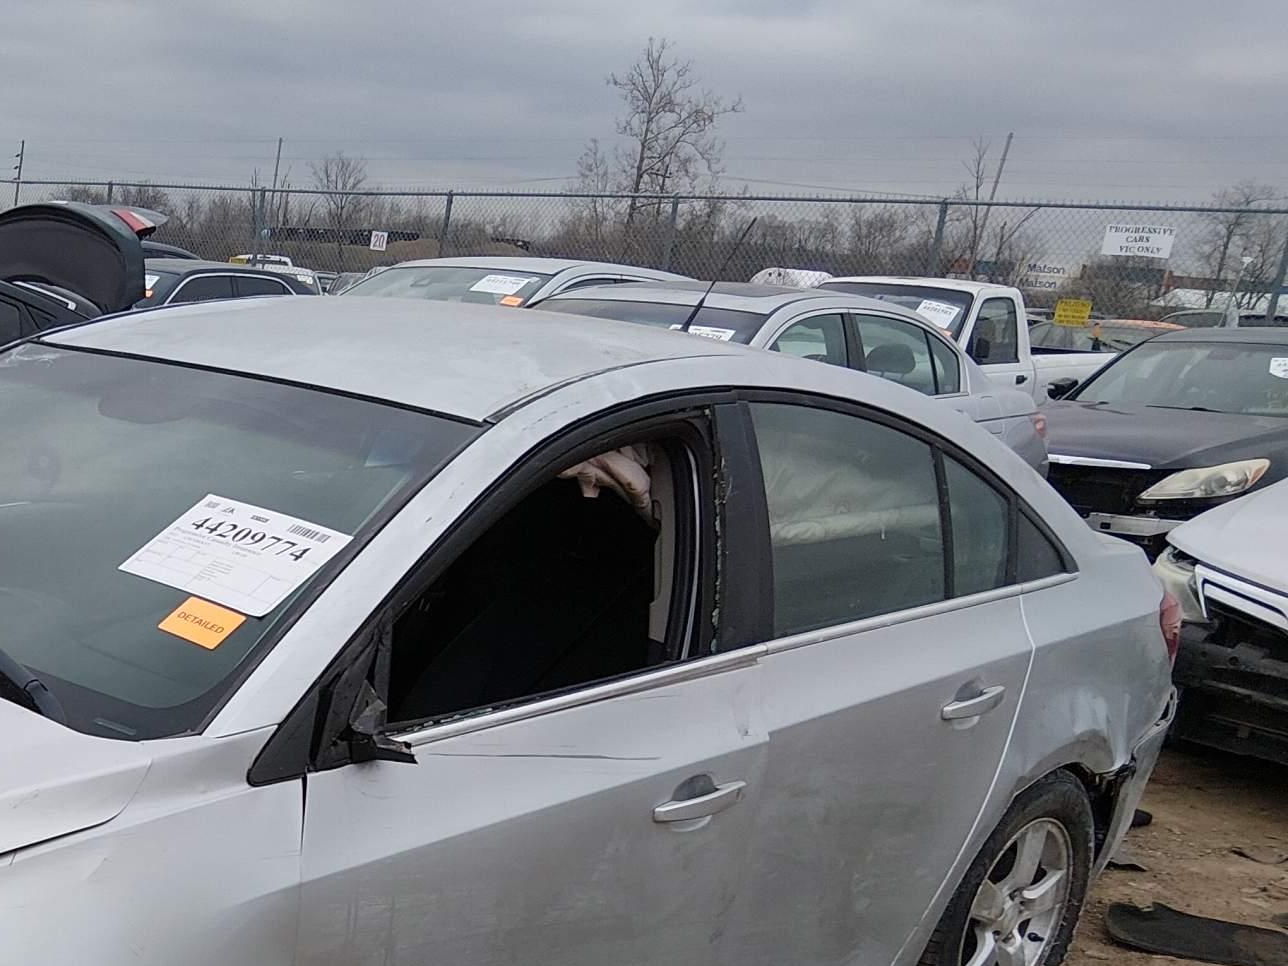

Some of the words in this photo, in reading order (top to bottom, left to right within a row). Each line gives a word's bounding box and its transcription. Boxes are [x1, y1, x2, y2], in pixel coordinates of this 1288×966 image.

[1108, 225, 1175, 236] PROGRESSIVE
[373, 234, 385, 248] 20
[1125, 235, 1151, 243] CARS
[1137, 245, 1162, 254] ONLY
[1027, 264, 1065, 274] Matson
[191, 516, 312, 562] 44209774
[177, 611, 225, 634] DETAILED
